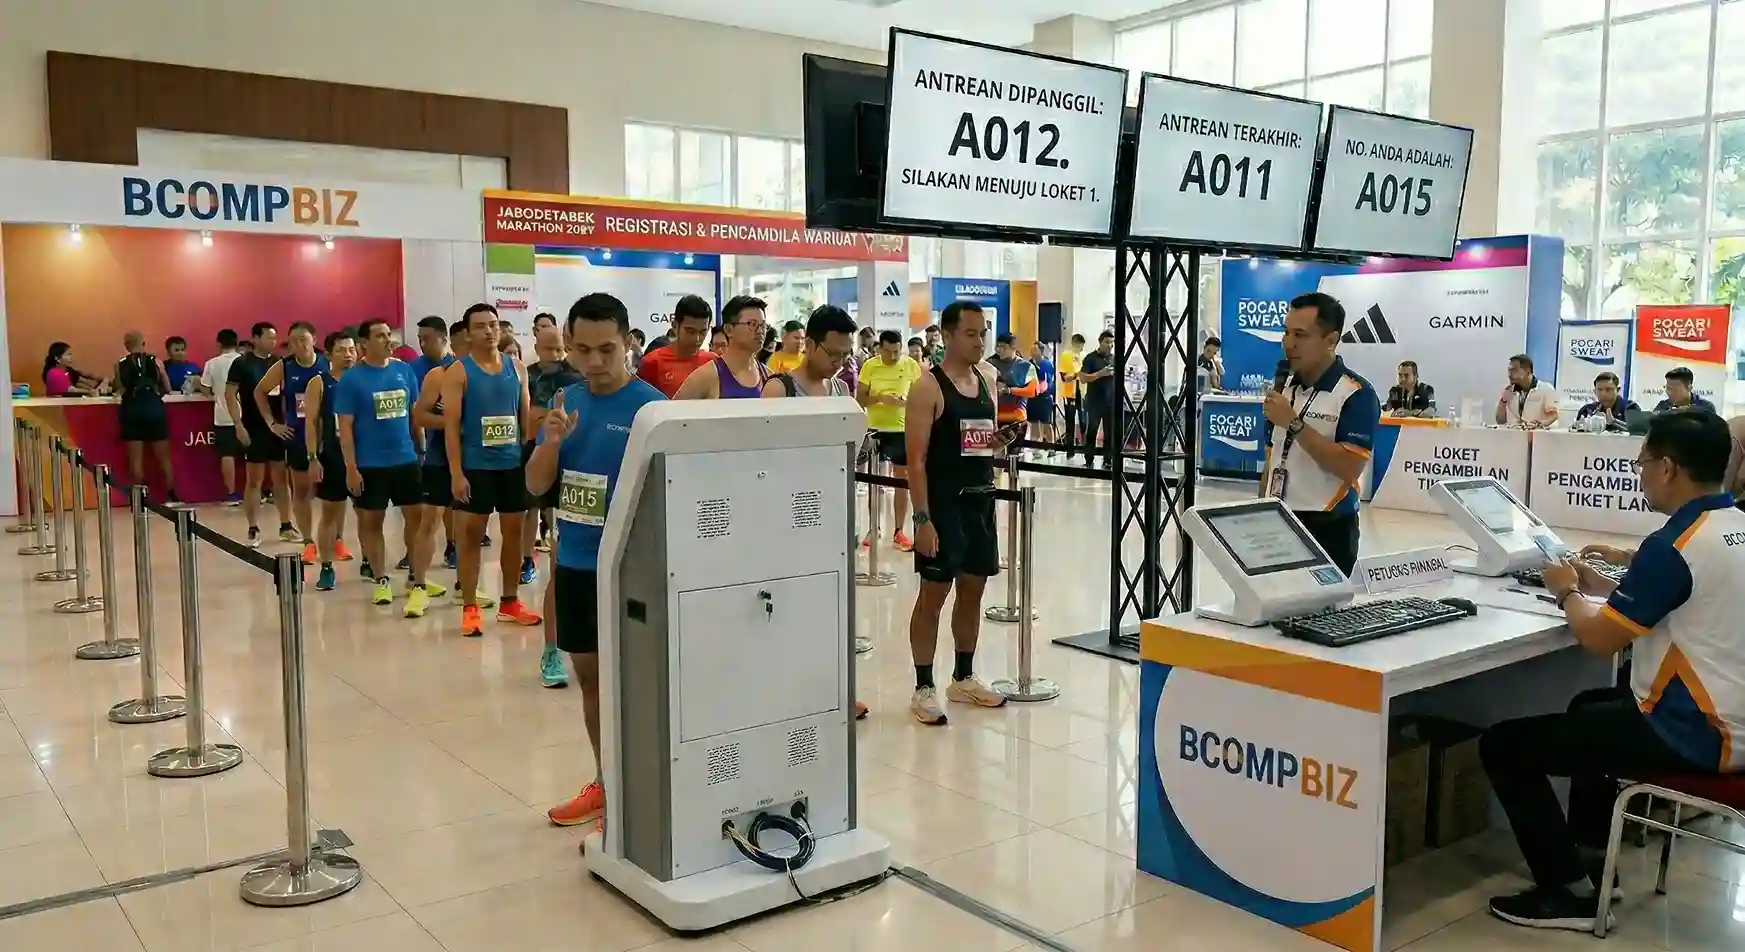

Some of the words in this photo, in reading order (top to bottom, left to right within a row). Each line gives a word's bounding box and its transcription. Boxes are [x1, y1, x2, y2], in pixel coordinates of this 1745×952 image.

[915, 69, 1003, 99] ANTREAN
[1008, 84, 1103, 115] DIPANGGIL:
[1159, 112, 1228, 139] ANTREAN
[1233, 124, 1302, 149] TERAKHIR:
[948, 112, 1069, 169] A012.
[1345, 139, 1367, 157] NO.
[1370, 143, 1402, 162] ANDA
[1404, 148, 1454, 169] ADALAH:
[1179, 150, 1272, 200] A011
[902, 168, 970, 190] SILAKAN
[975, 176, 1036, 199] MENUJU
[1041, 182, 1086, 202] LOKET
[1089, 187, 1100, 202] 1.
[123, 177, 360, 227] BCOMPBIZ
[1355, 172, 1433, 216] A015
[497, 206, 595, 224] JABODETABEK
[497, 220, 563, 233] MARATHON
[605, 216, 692, 237] REGISTRASI
[696, 223, 706, 237] &
[711, 224, 800, 243] PENCAMDILA
[1429, 315, 1504, 328] GARMIN
[1653, 318, 1710, 328] POCARI
[1652, 328, 1704, 337] SWEAT
[1571, 339, 1614, 348] POCARI
[1571, 347, 1610, 356] SWEAT
[380, 399, 405, 409] A012
[486, 425, 514, 436] A012
[1209, 425, 1251, 437] SWEAT
[1434, 446, 1480, 461] LOKET
[1583, 456, 1630, 472] LOKE
[562, 486, 597, 507] A015
[1566, 491, 1614, 508] TIKET
[1723, 532, 1745, 547] BCO
[1180, 724, 1357, 809] BCOMPBIZ
